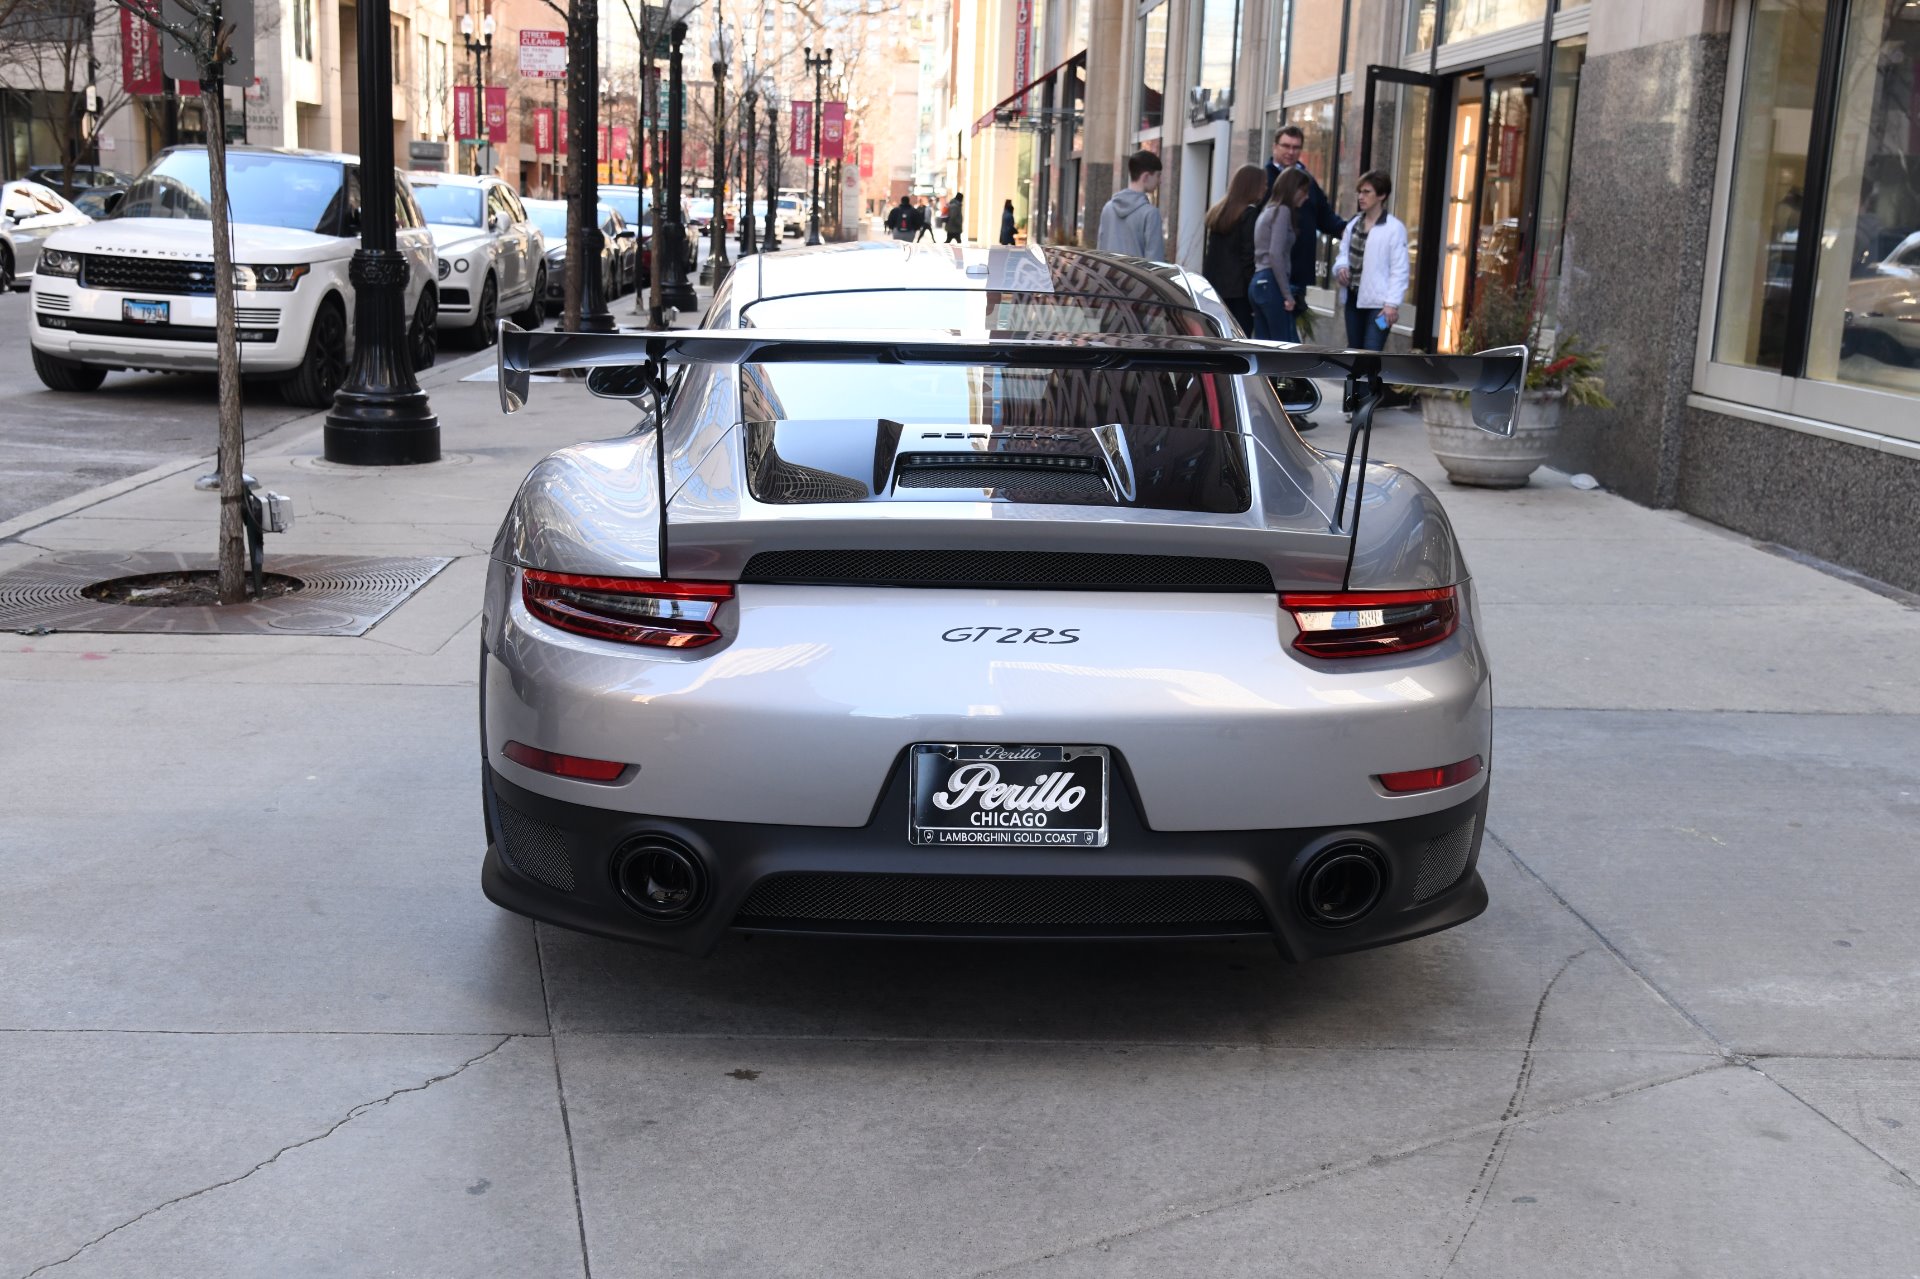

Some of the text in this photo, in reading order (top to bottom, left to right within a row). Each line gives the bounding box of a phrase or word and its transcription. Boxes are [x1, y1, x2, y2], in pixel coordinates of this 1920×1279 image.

[521, 31, 549, 39] STREET
[521, 38, 561, 46] CLEANING
[458, 92, 466, 135] WELCOME
[95, 246, 149, 255] RANGE
[979, 746, 1042, 760] Perillo
[932, 763, 1086, 812] Perillo
[970, 812, 1048, 827] CHICAGO
[939, 831, 1078, 844] LAMBORGHINI GOLD COAST
